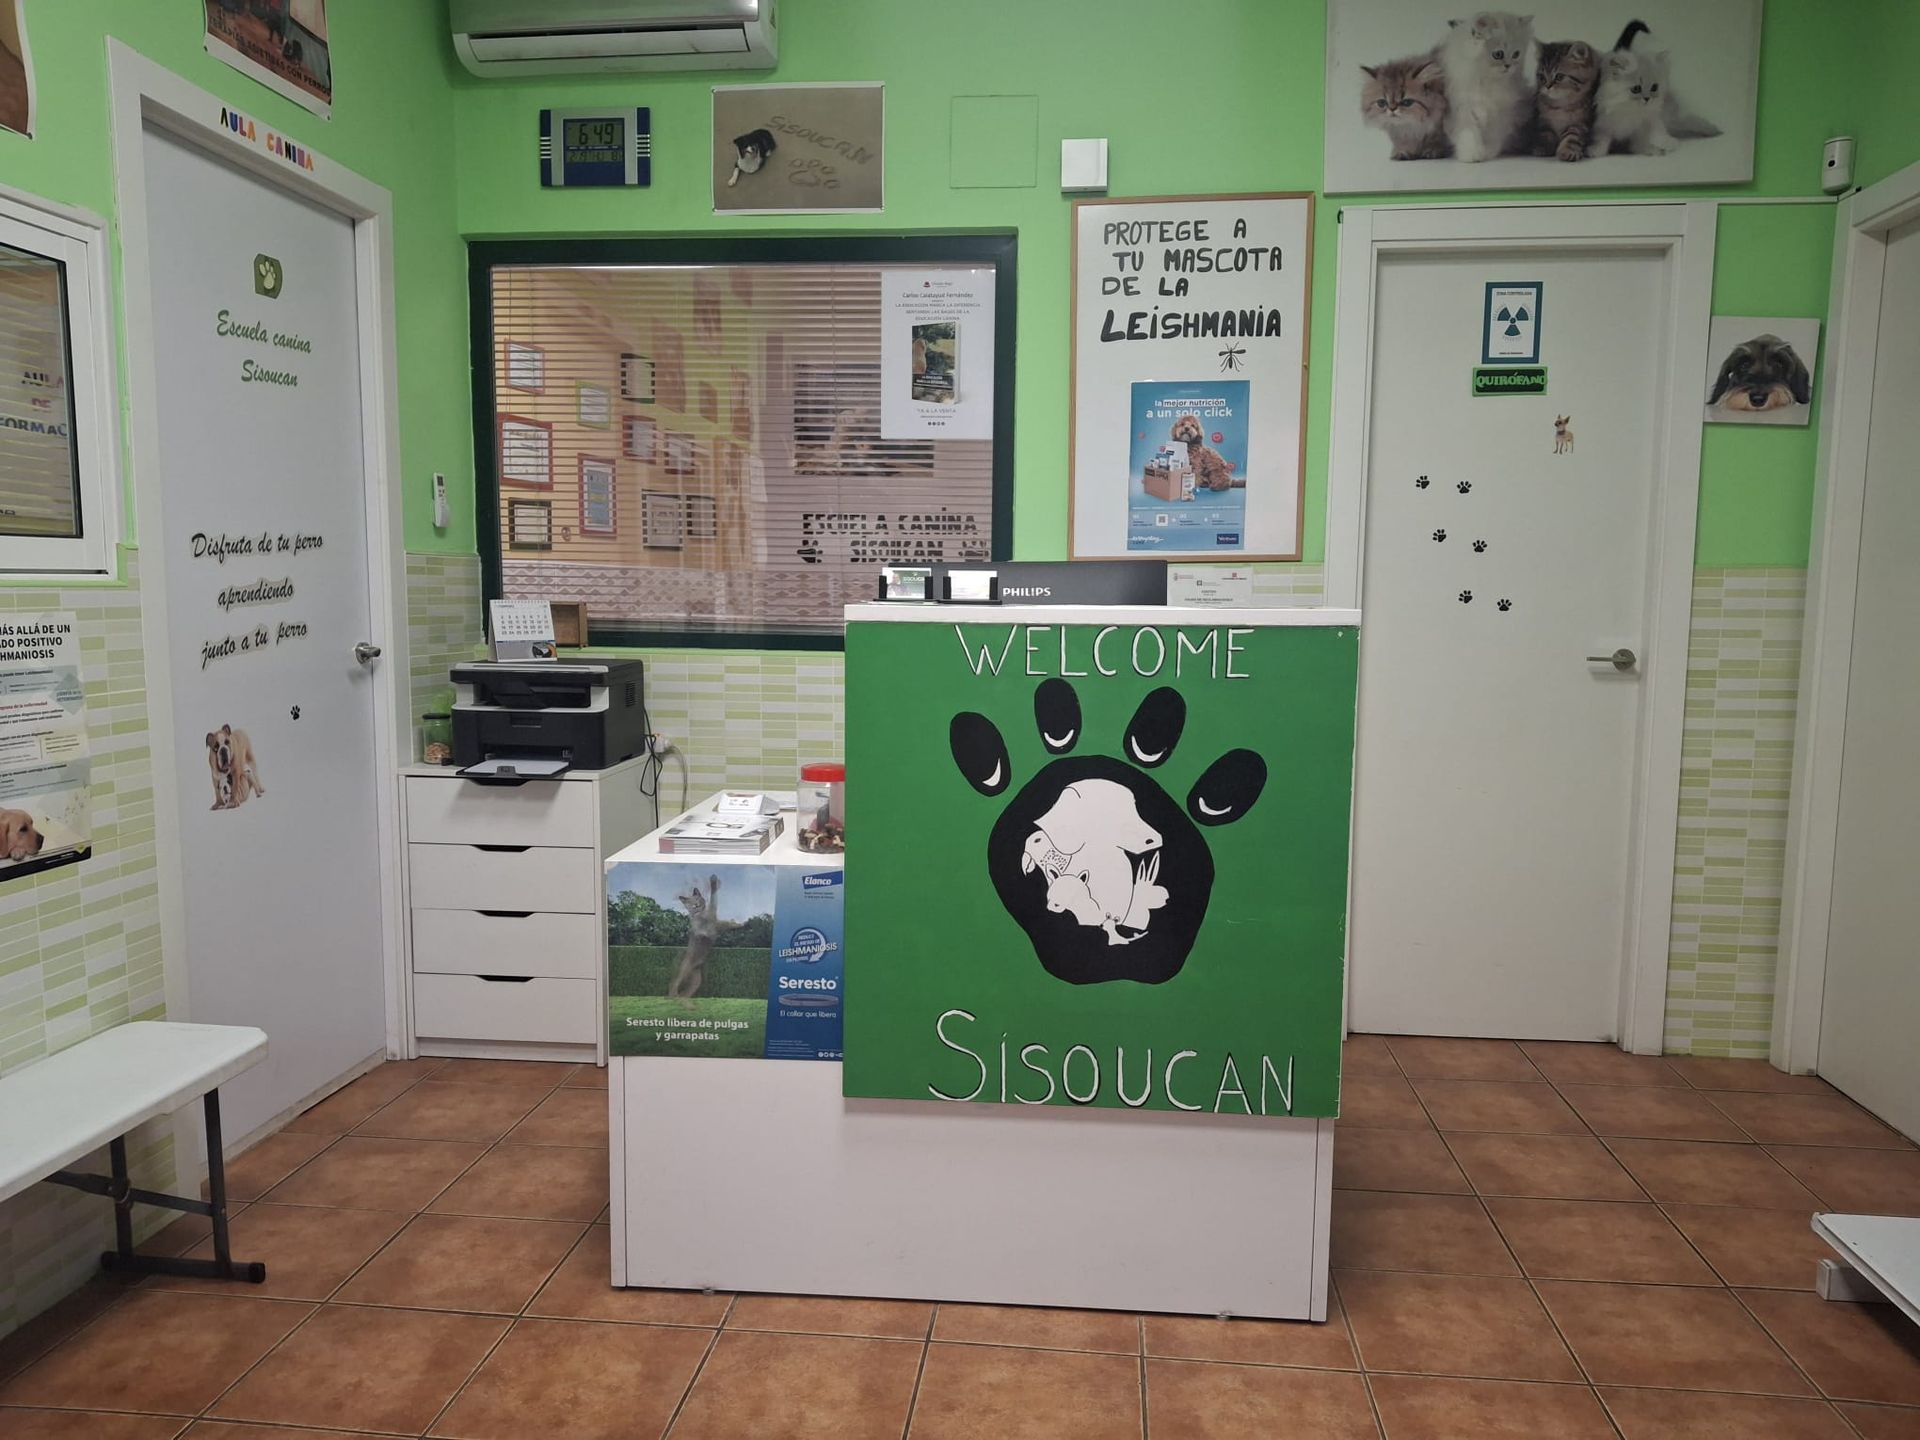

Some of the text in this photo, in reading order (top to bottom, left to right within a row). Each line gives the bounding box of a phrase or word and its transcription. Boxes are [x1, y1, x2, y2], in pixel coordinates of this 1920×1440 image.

[220, 106, 314, 171] AULA CANINA
[1103, 218, 1247, 246] PROTEGE A
[1112, 246, 1282, 273] TU MASCOTA
[1101, 276, 1189, 297] DE LA
[216, 309, 312, 354] Escuela canina
[241, 359, 298, 387] Sisoucan
[1475, 372, 1548, 388] QUIRÓFANO
[1164, 400, 1187, 408] mejor
[1189, 399, 1225, 407] nutrición
[1146, 407, 1233, 419] a un solo click
[803, 513, 889, 535] ESCUELA
[191, 531, 323, 564] Disfruta de tu perro
[217, 577, 294, 613] aprendiendo
[1002, 587, 1051, 597] PHILIPS
[16, 623, 41, 635] ALLÁ
[42, 625, 55, 634] DE
[57, 624, 71, 634] UN
[17, 637, 63, 648] POSITIVO
[201, 621, 307, 671] junto a tu perro
[0, 649, 55, 661] HMANIOSIS
[954, 625, 1255, 679] WELCOME
[804, 876, 832, 886] Elanco
[778, 942, 838, 957] LEISHMANIOSIS
[779, 976, 837, 990] Seresto
[786, 1010, 804, 1018] collar
[818, 1010, 837, 1018] libera
[626, 1017, 750, 1031] Seresto libera de pulgas
[655, 1031, 720, 1042] y garrapatas
